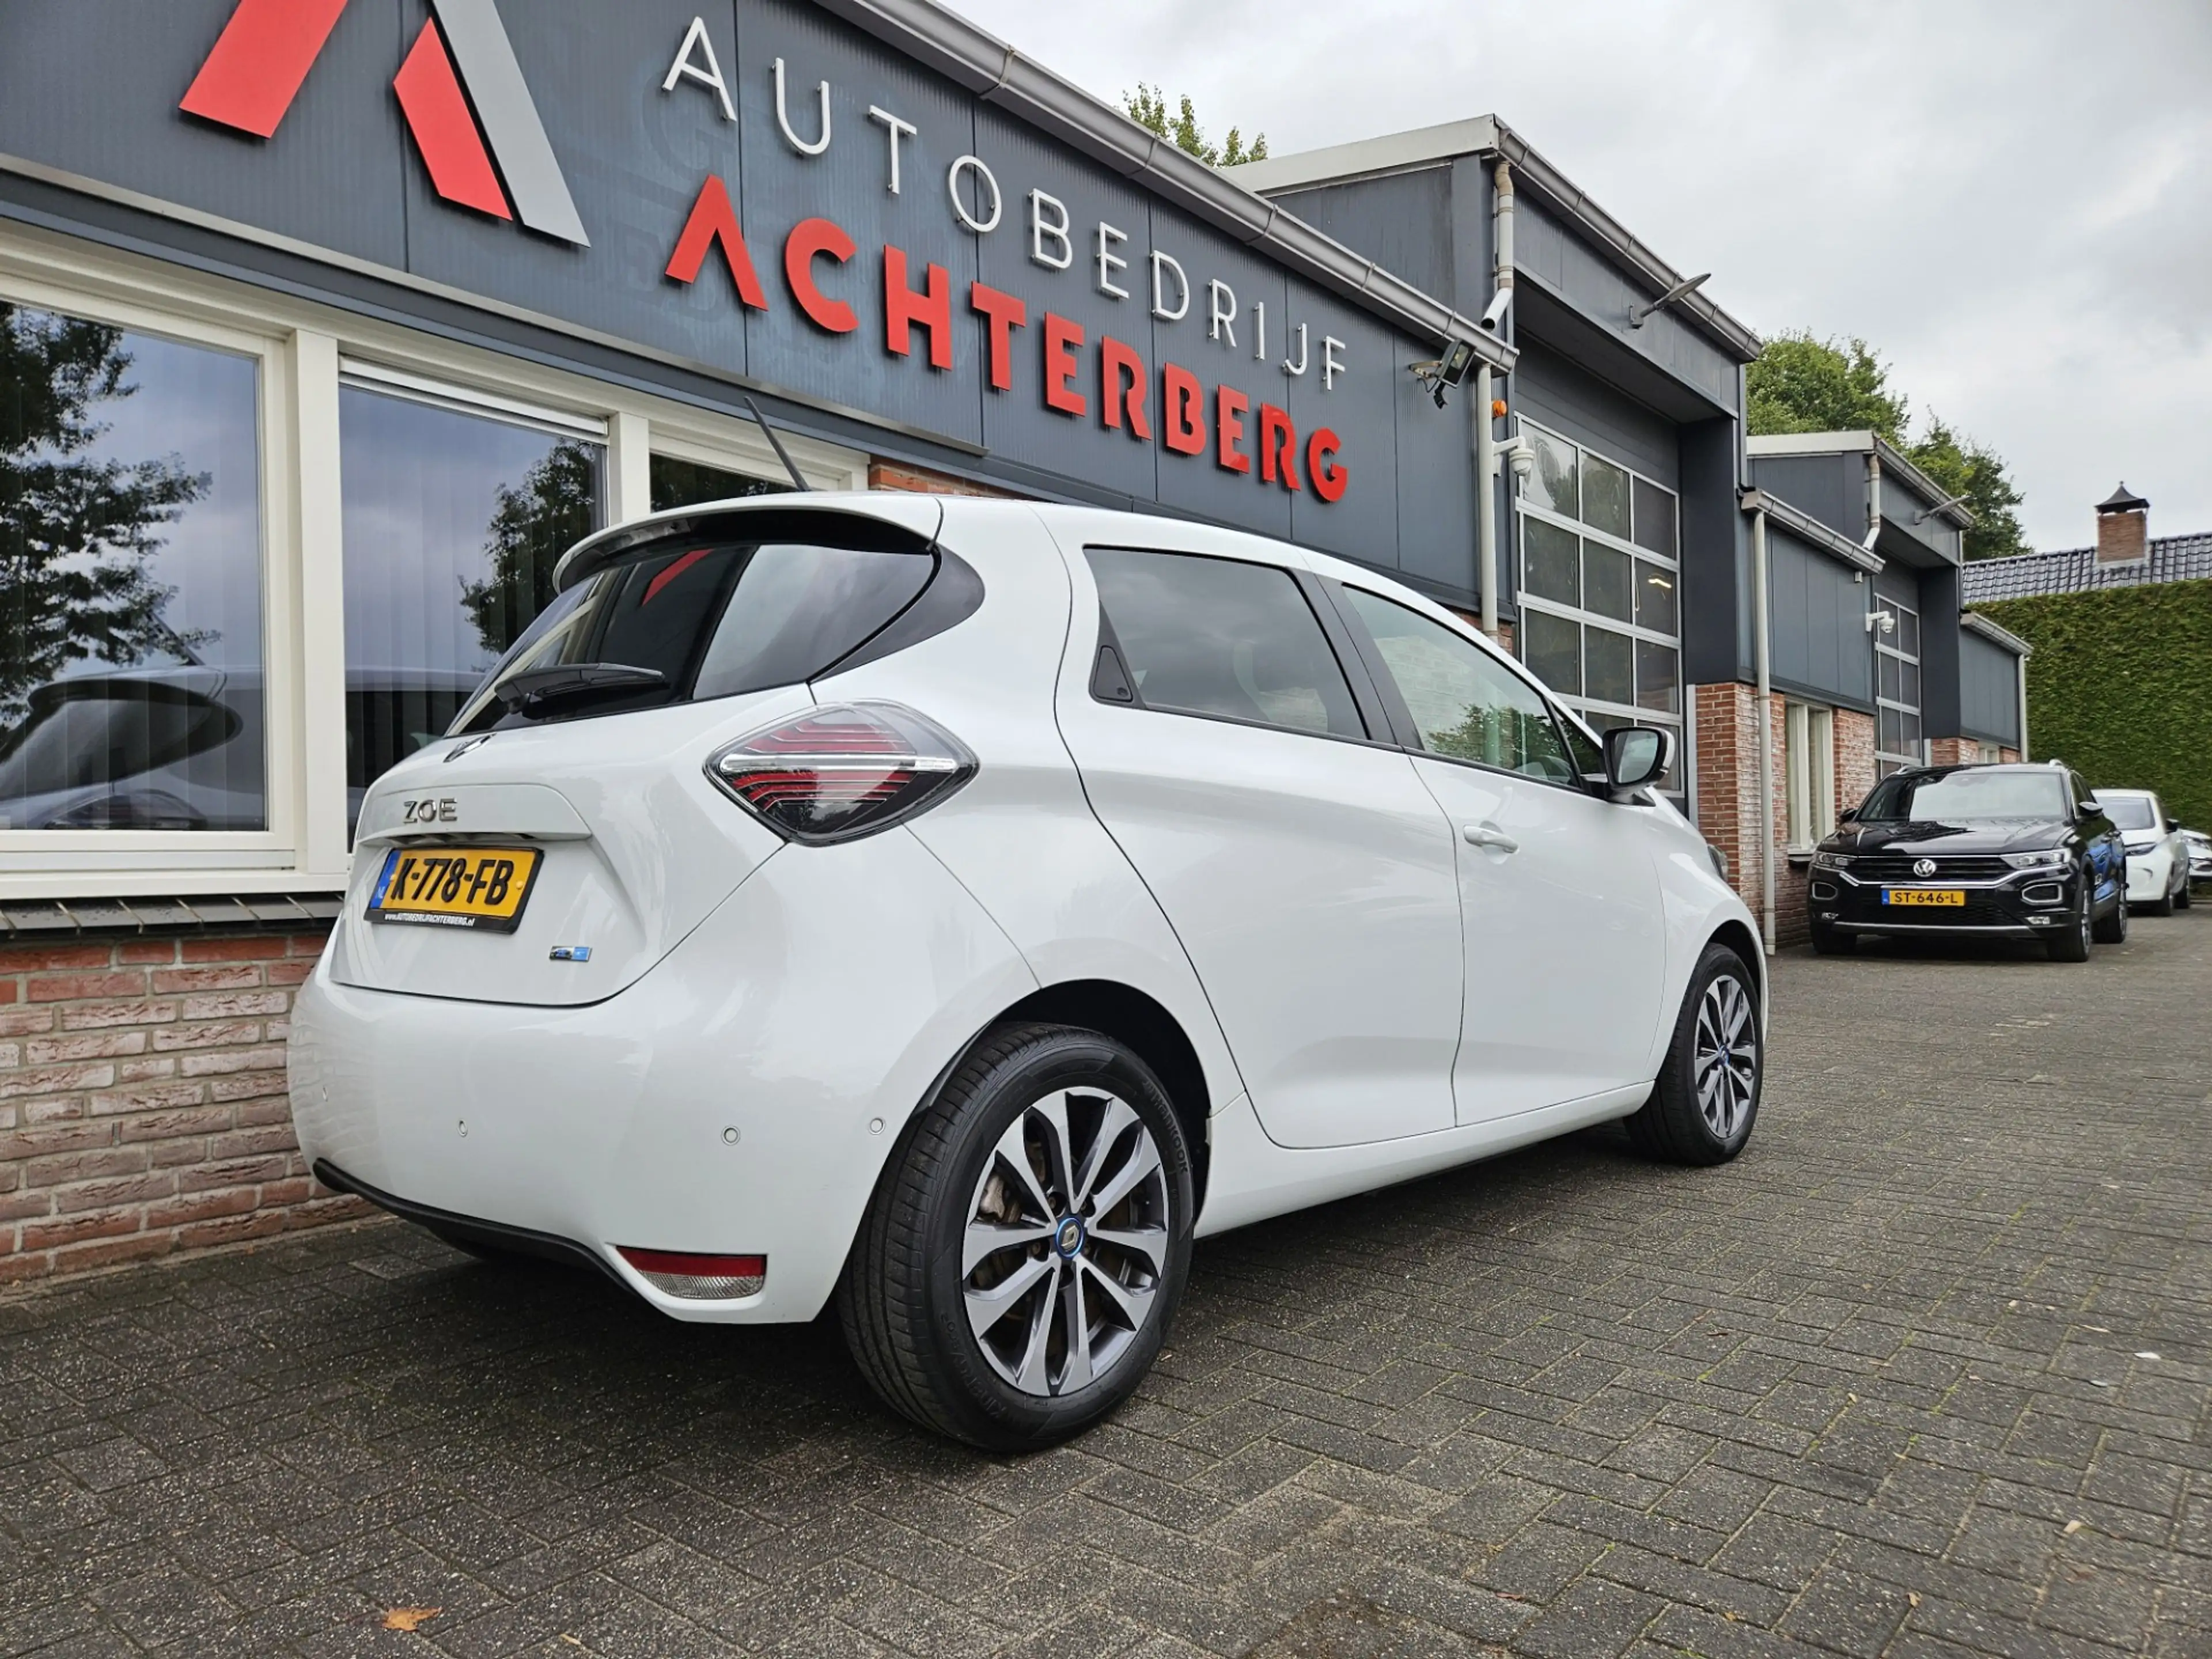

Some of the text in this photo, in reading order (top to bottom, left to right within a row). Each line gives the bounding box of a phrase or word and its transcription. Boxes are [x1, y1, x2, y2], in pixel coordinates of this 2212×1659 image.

[662, 16, 1346, 390] AUTOBEDRIJF
[665, 174, 1348, 502] ACHTERBERG
[404, 798, 457, 823] ZOE
[391, 858, 514, 905] K-778-FB
[1895, 892, 1958, 903] ST-646-L
